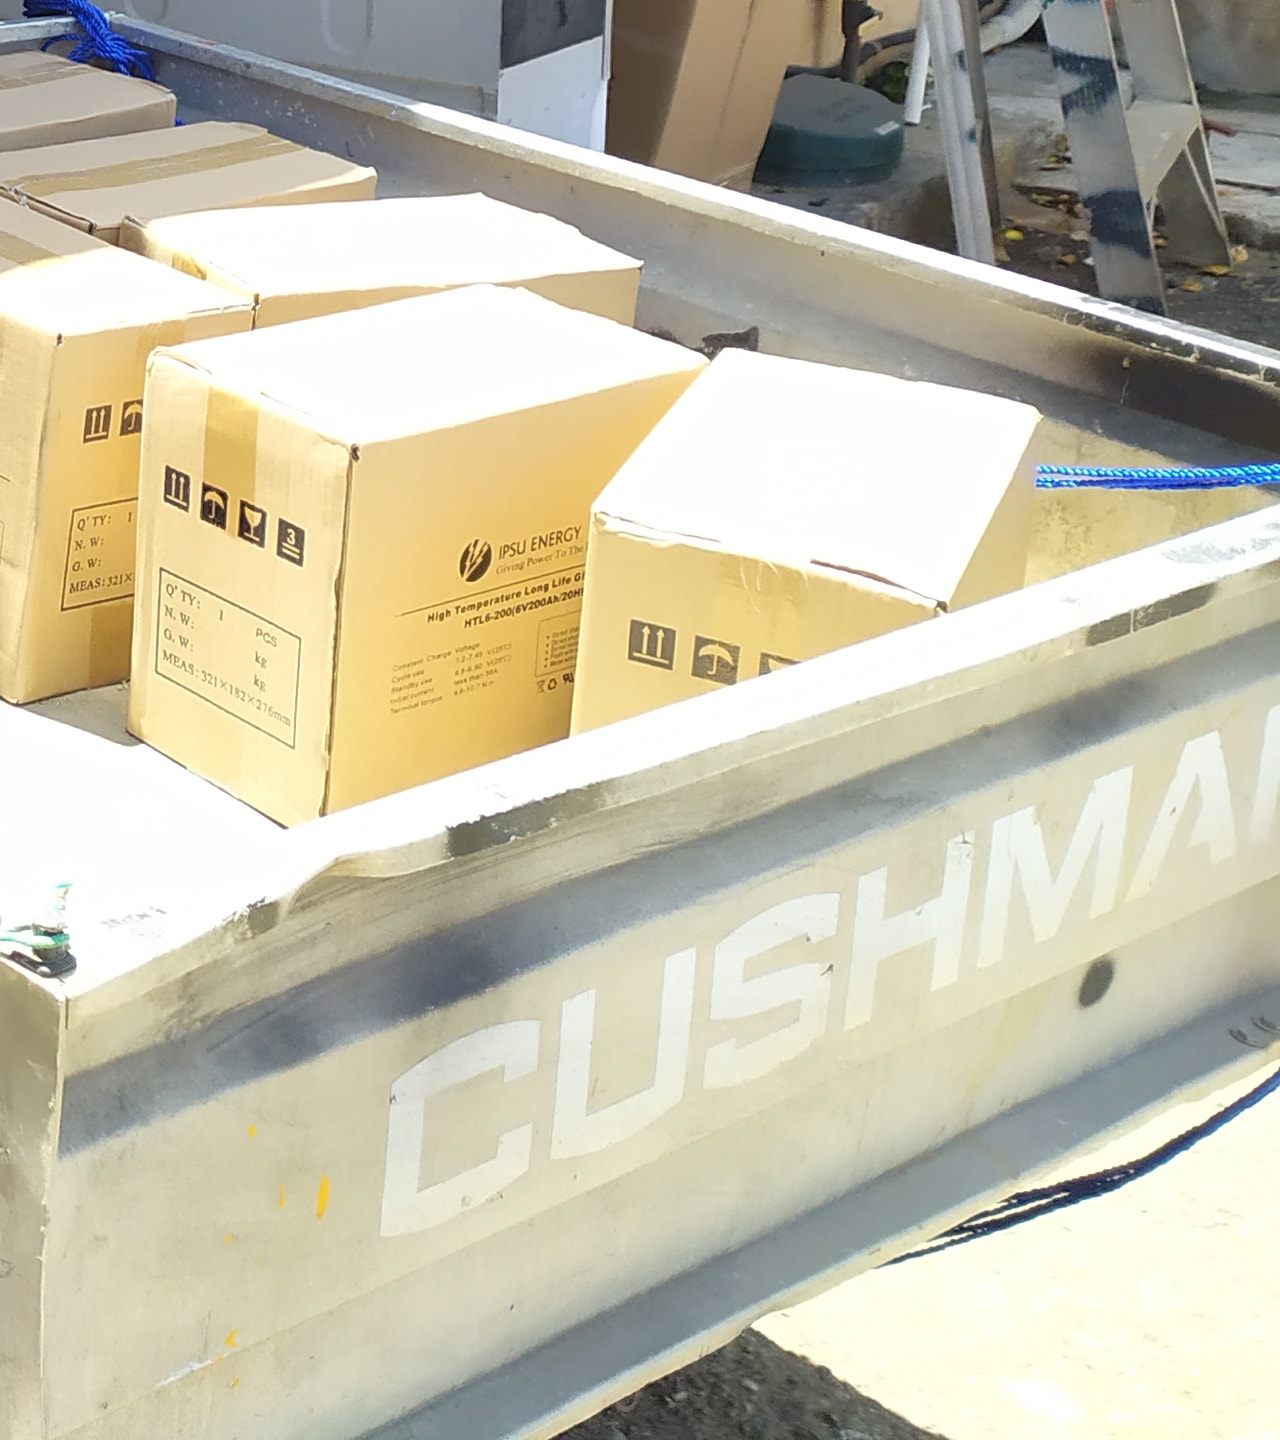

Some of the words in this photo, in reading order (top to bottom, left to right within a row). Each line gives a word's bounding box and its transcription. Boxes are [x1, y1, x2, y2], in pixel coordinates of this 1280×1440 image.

[286, 528, 296, 545] 3
[498, 539, 527, 561] IPSU
[530, 524, 583, 552] ENERGY
[496, 560, 526, 576] Giving
[527, 553, 553, 567] Power
[555, 548, 567, 559] To
[569, 544, 584, 556] The
[426, 609, 451, 624] High
[454, 590, 522, 616] Temperature
[524, 582, 550, 597] Long
[551, 575, 572, 588] Life
[255, 627, 278, 648] PCS
[254, 650, 268, 670] kg
[253, 673, 266, 692] kg
